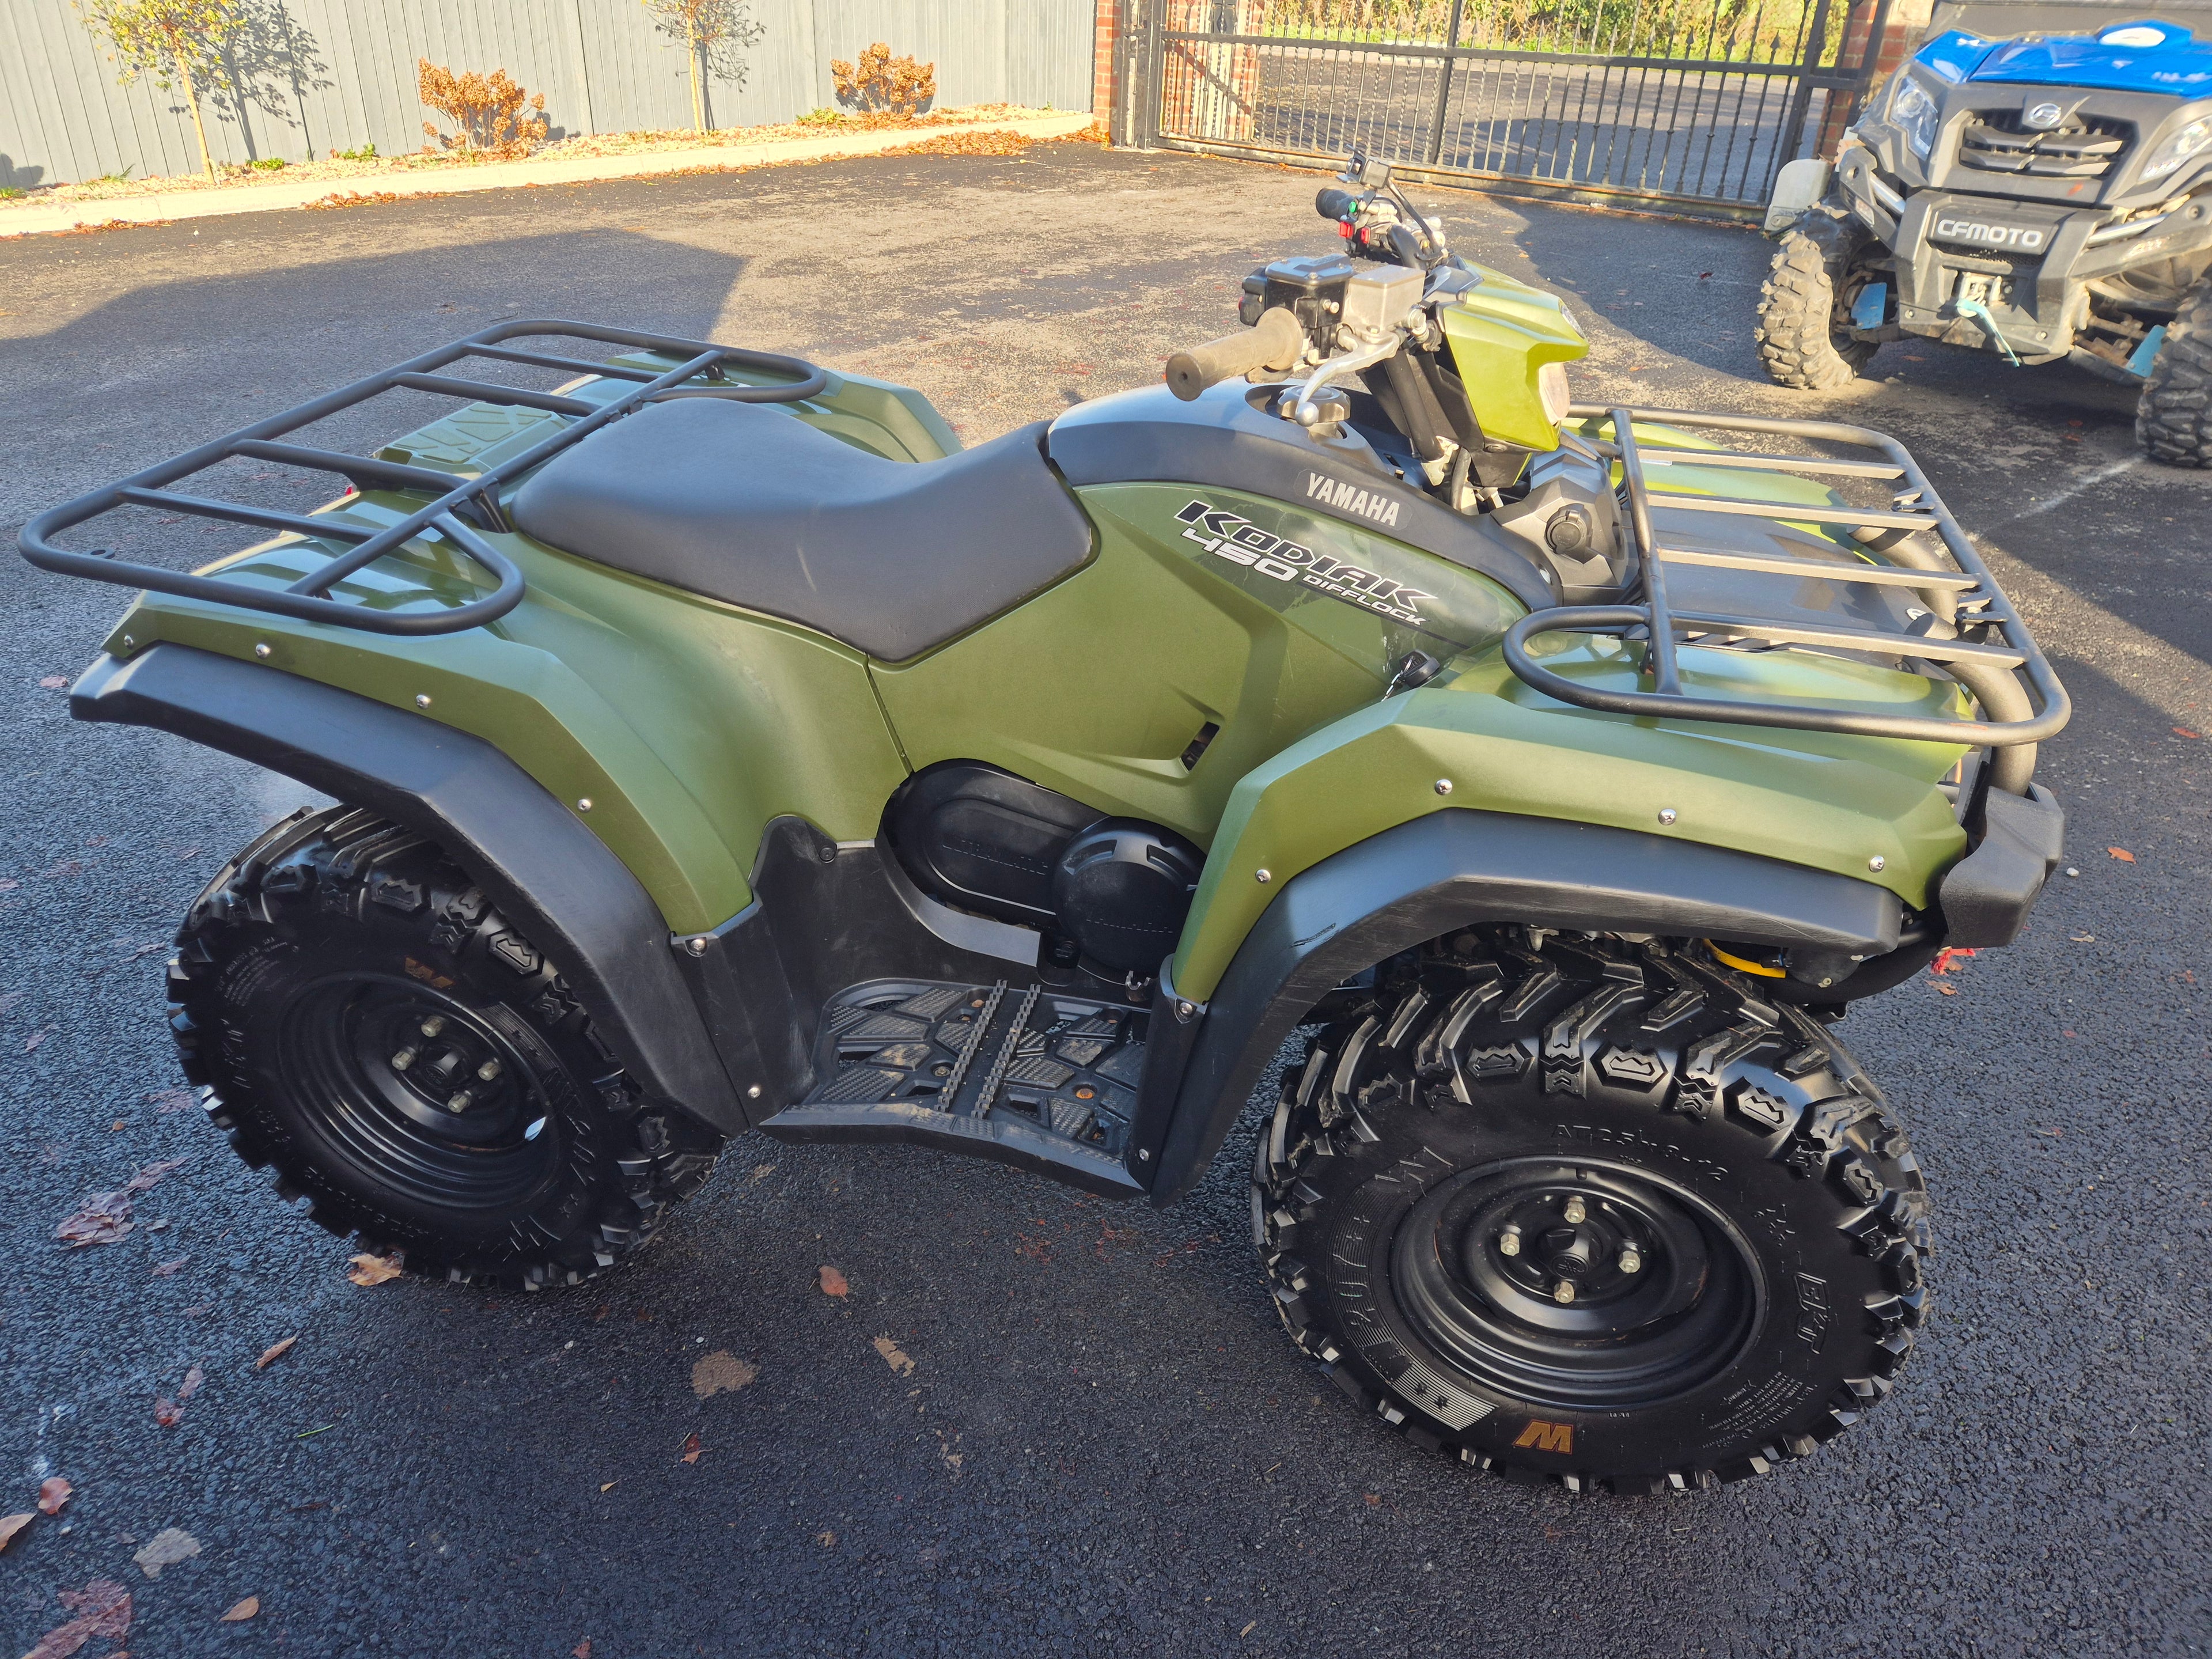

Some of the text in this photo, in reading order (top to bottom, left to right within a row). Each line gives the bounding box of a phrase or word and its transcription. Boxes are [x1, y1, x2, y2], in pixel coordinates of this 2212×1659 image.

[1937, 219, 2043, 248] CFMOTO
[1306, 472, 1400, 527] YAMAHA
[1173, 499, 1438, 612] KODIAK
[1180, 527, 1427, 626] 450 DIFFLOCK
